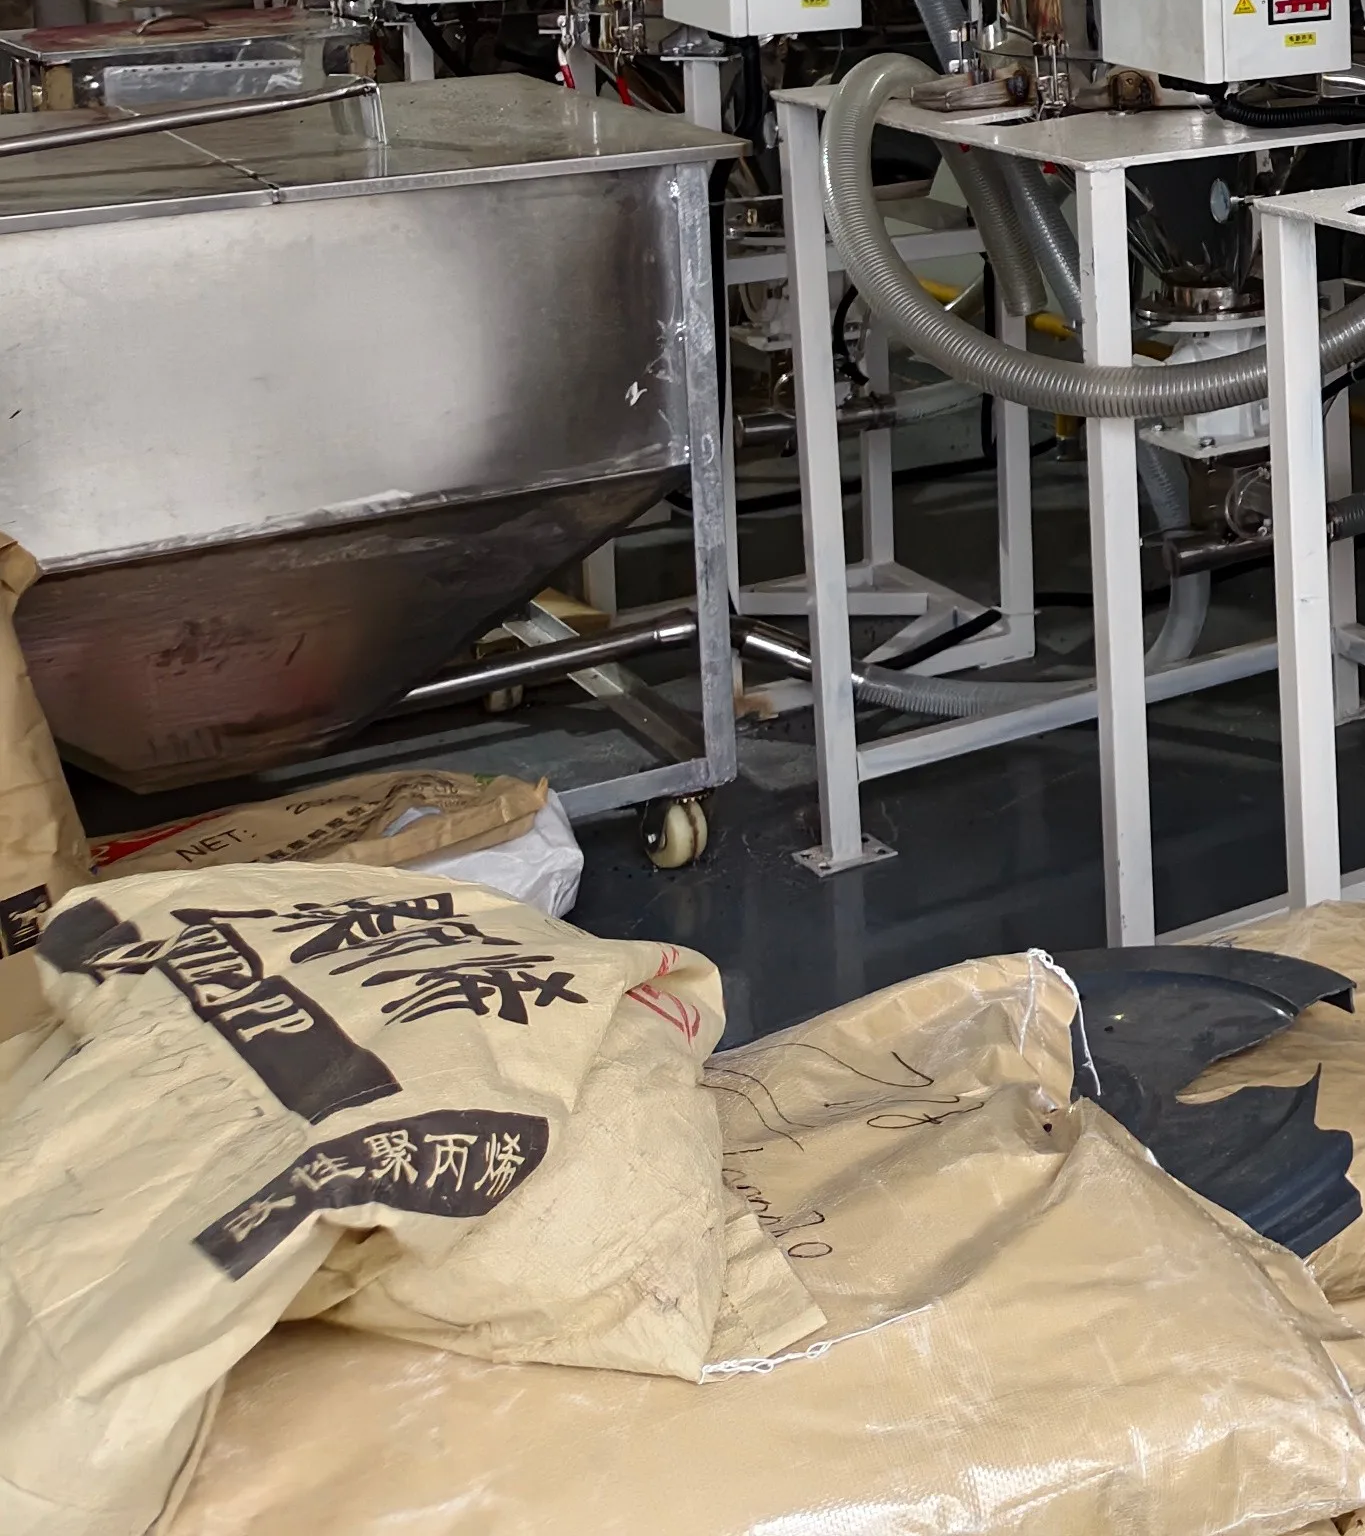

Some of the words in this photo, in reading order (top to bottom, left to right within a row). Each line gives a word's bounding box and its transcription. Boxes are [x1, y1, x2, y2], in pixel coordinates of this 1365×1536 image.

[219, 991, 316, 1043] PP
[224, 1131, 527, 1243] 改性聚丙烯
